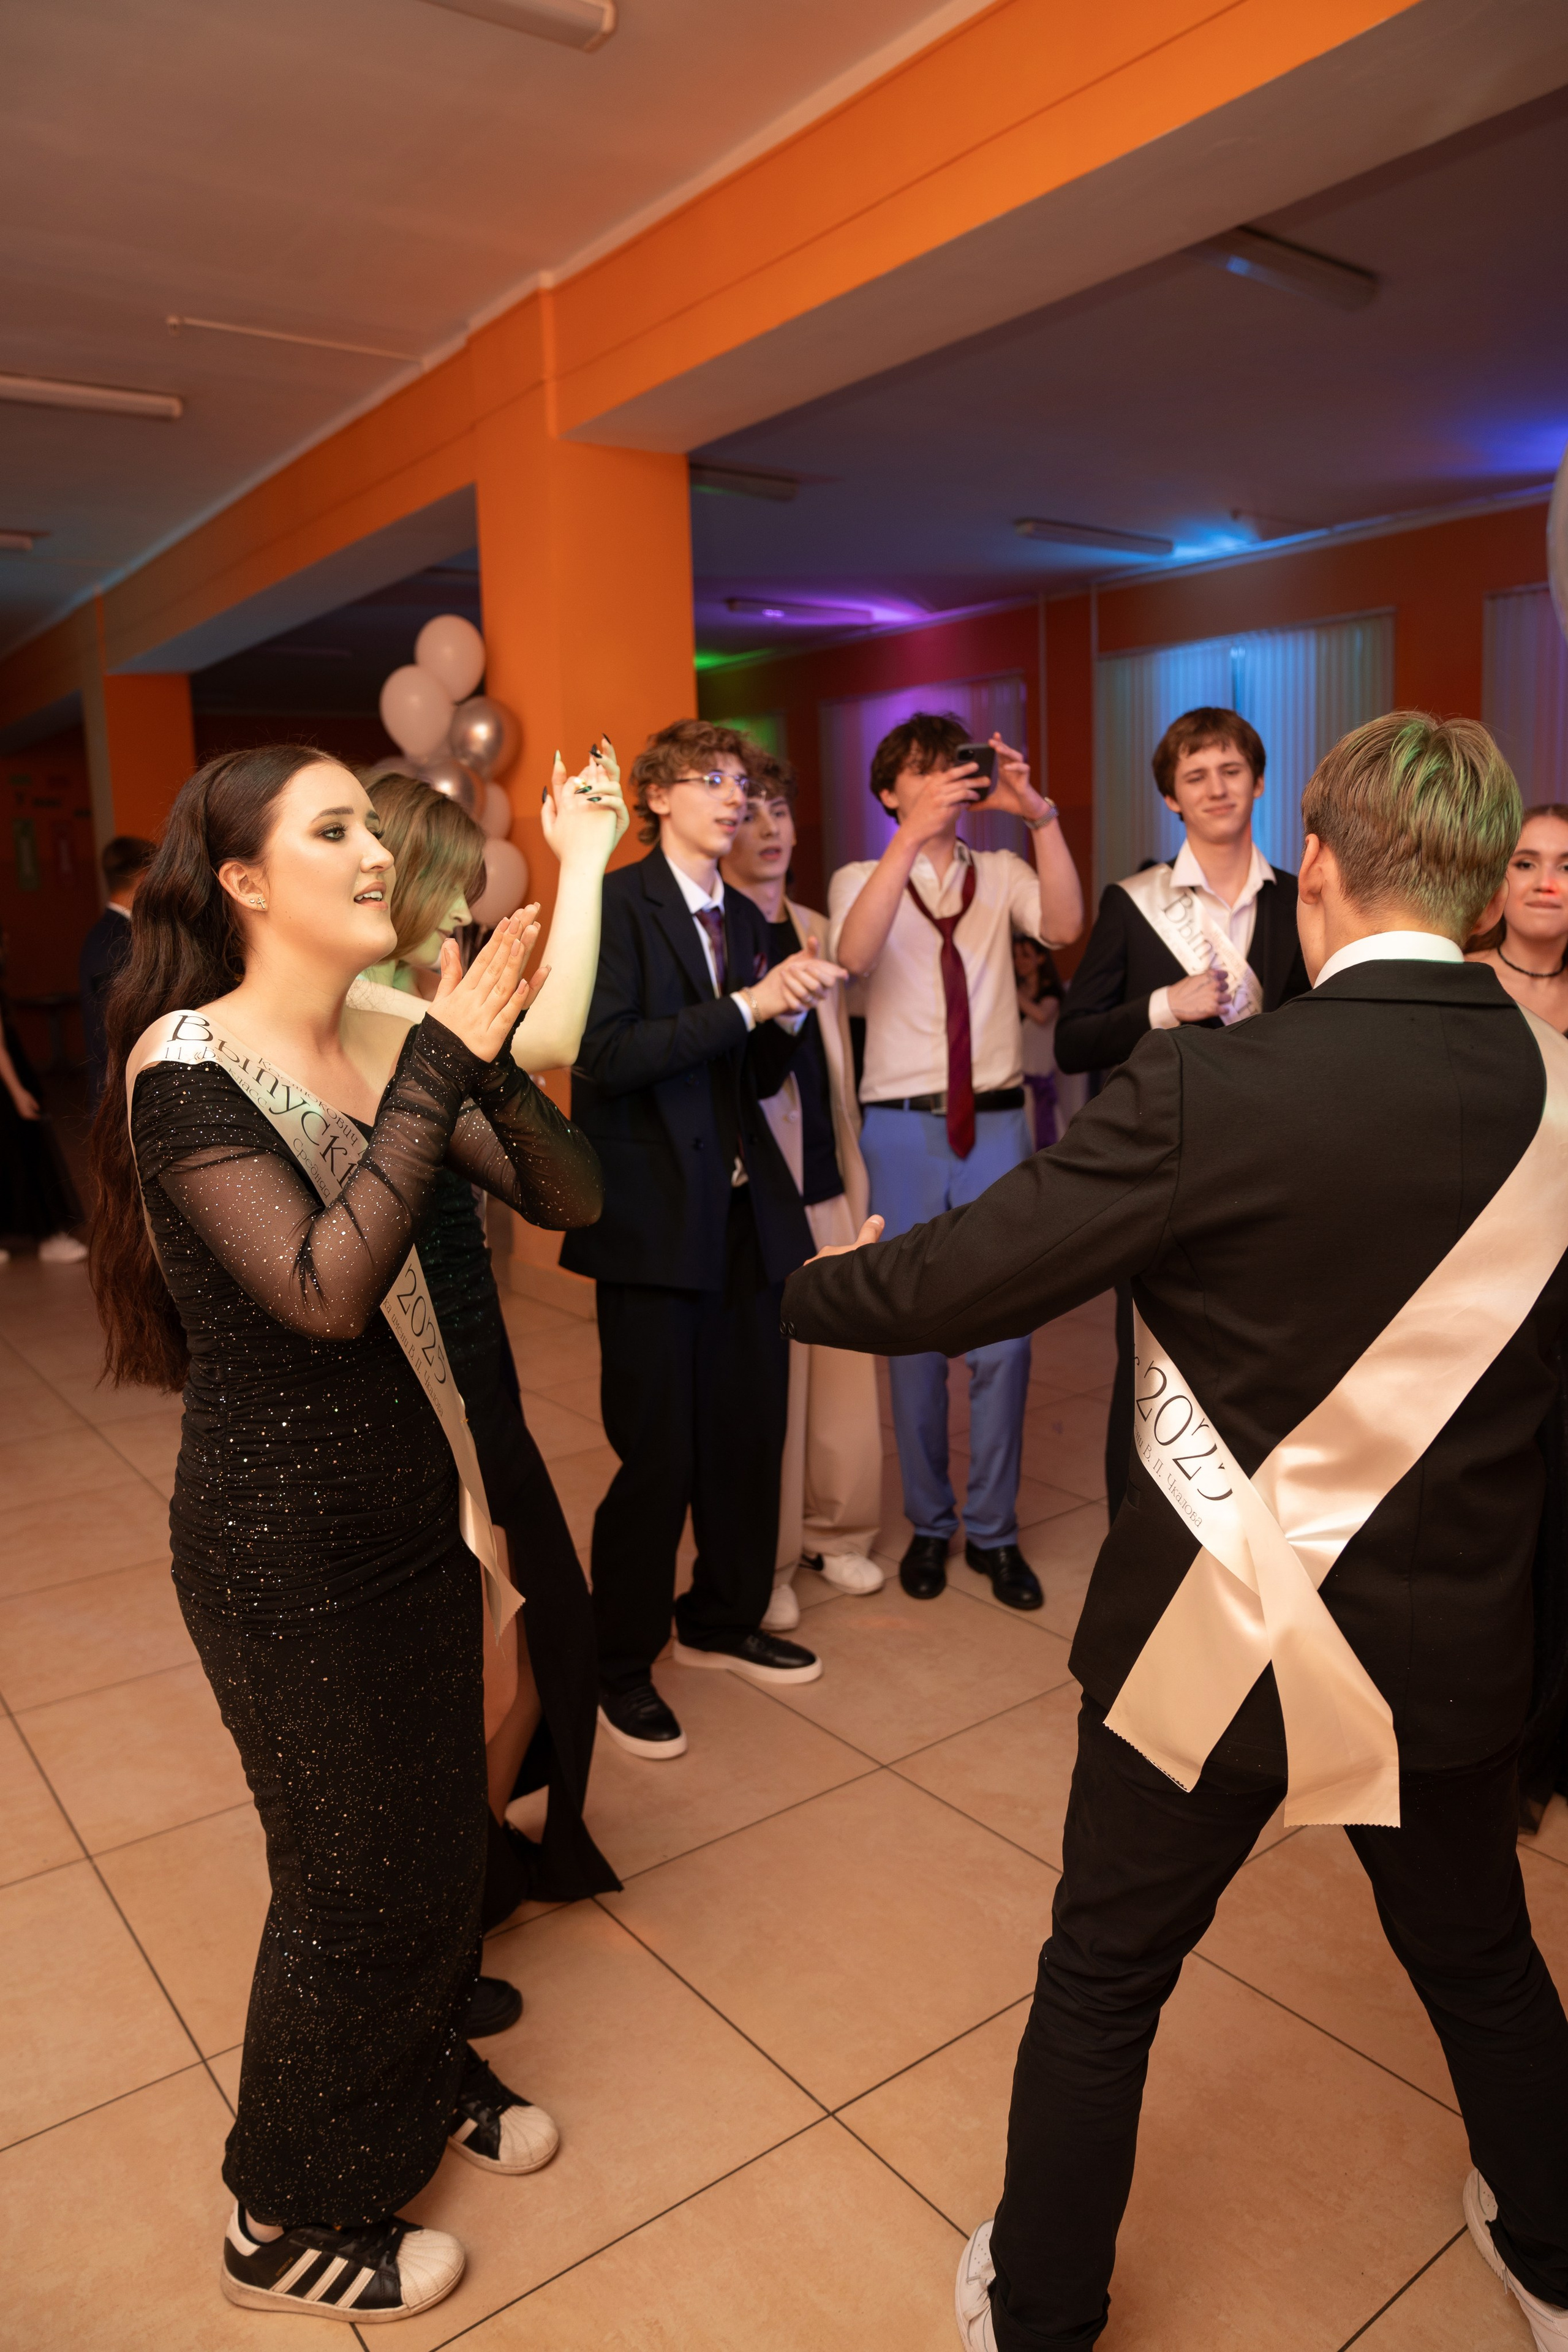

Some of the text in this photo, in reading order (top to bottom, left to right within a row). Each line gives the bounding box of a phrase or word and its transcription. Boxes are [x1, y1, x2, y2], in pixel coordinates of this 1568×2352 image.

[227, 1068, 267, 1108] класс
[293, 1137, 331, 1199] Средняя
[391, 1314, 409, 1348] имени
[424, 1370, 444, 1417] Чкалова
[396, 1263, 446, 1385] 2025
[1167, 1473, 1203, 1528] Чкалова
